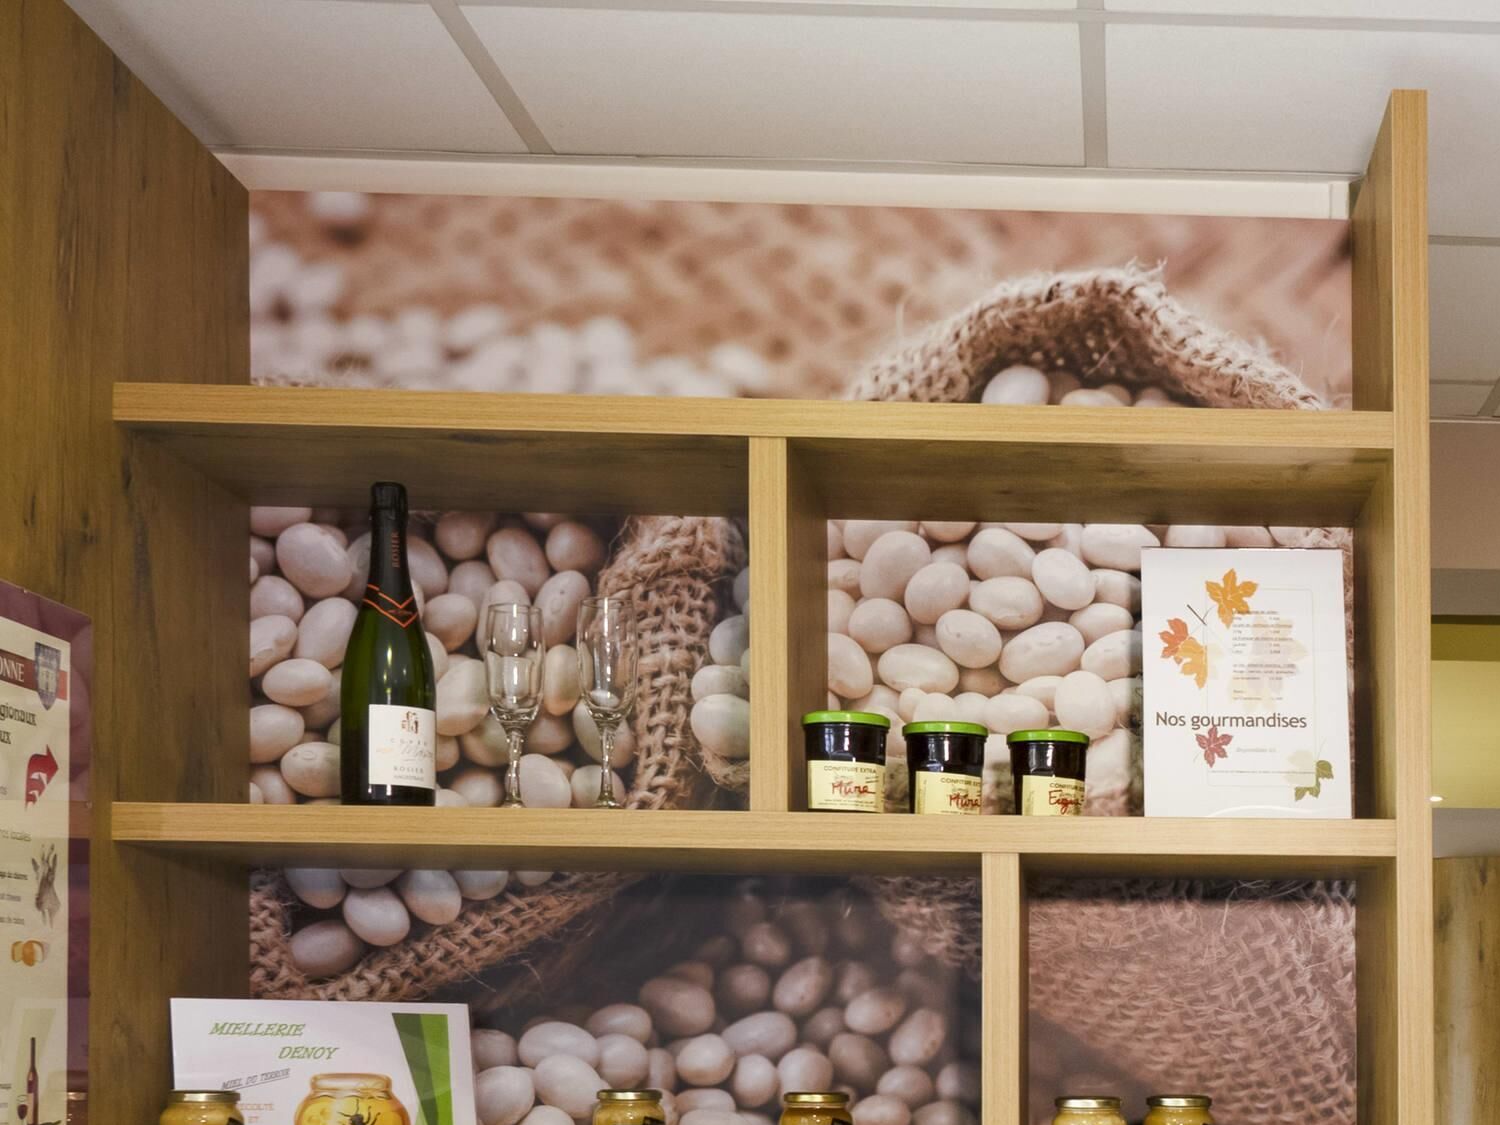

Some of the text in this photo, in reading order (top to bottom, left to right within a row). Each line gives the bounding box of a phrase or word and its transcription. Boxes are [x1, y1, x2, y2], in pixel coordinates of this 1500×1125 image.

[0, 656, 25, 683] NNE
[1155, 712, 1307, 731] Nos gourmandises
[208, 1022, 306, 1037] MIELLERIE
[278, 1045, 340, 1060] DENOY
